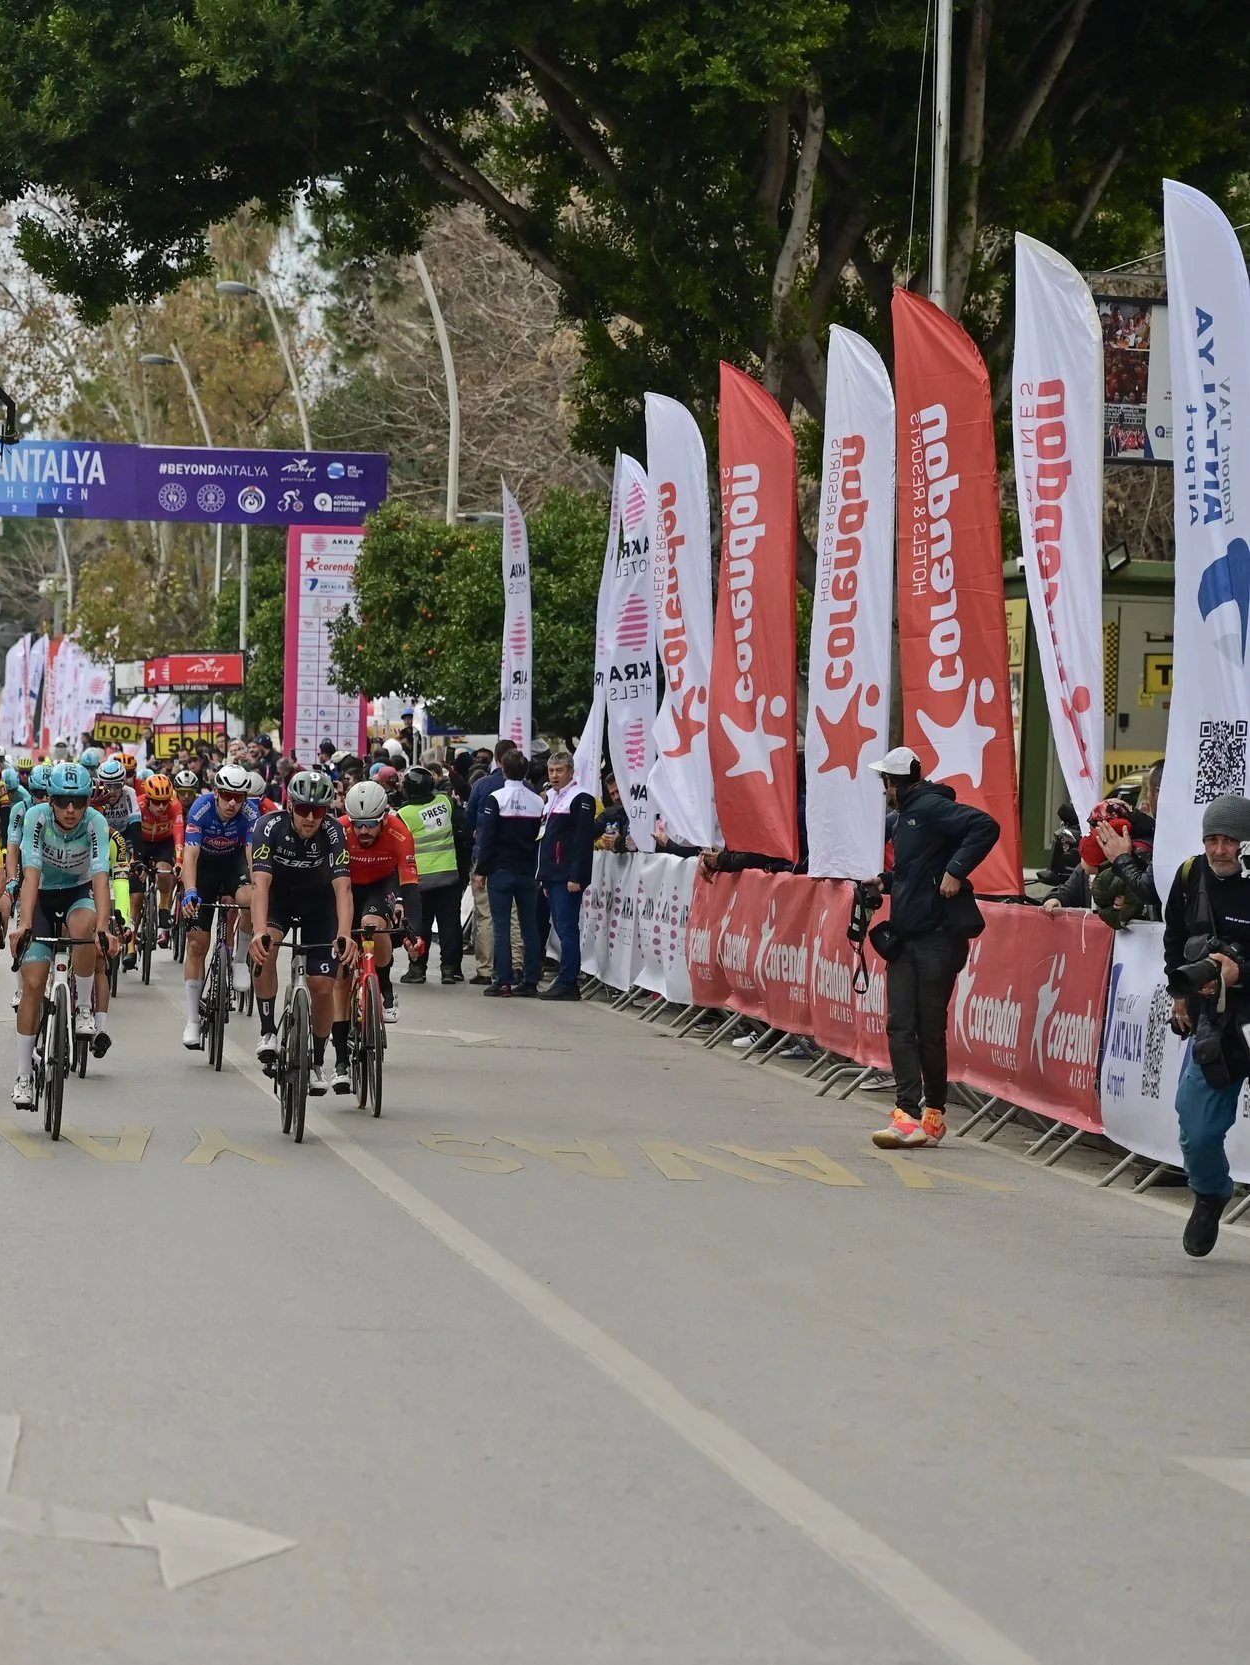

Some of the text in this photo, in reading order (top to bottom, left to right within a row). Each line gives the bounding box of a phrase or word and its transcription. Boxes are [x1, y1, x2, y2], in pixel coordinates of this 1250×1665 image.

[158, 463, 269, 478] #BEYONDANTALYA
[7, 486, 89, 501] HEAVEN
[11, 505, 18, 513] 2
[57, 506, 64, 515] 4
[318, 563, 354, 572] corendo
[100, 725, 132, 740] 100
[168, 737, 195, 754] 50
[421, 803, 448, 821] PRESS
[436, 817, 442, 827] 8
[327, 826, 339, 845] UBS
[283, 848, 296, 857] UBS
[272, 854, 325, 868] Q36.5
[968, 985, 1023, 1051] corendon
[1110, 1019, 1143, 1063] ANTALYA
[990, 1049, 1018, 1073] AIRLINES
[1106, 1065, 1125, 1105] Airport
